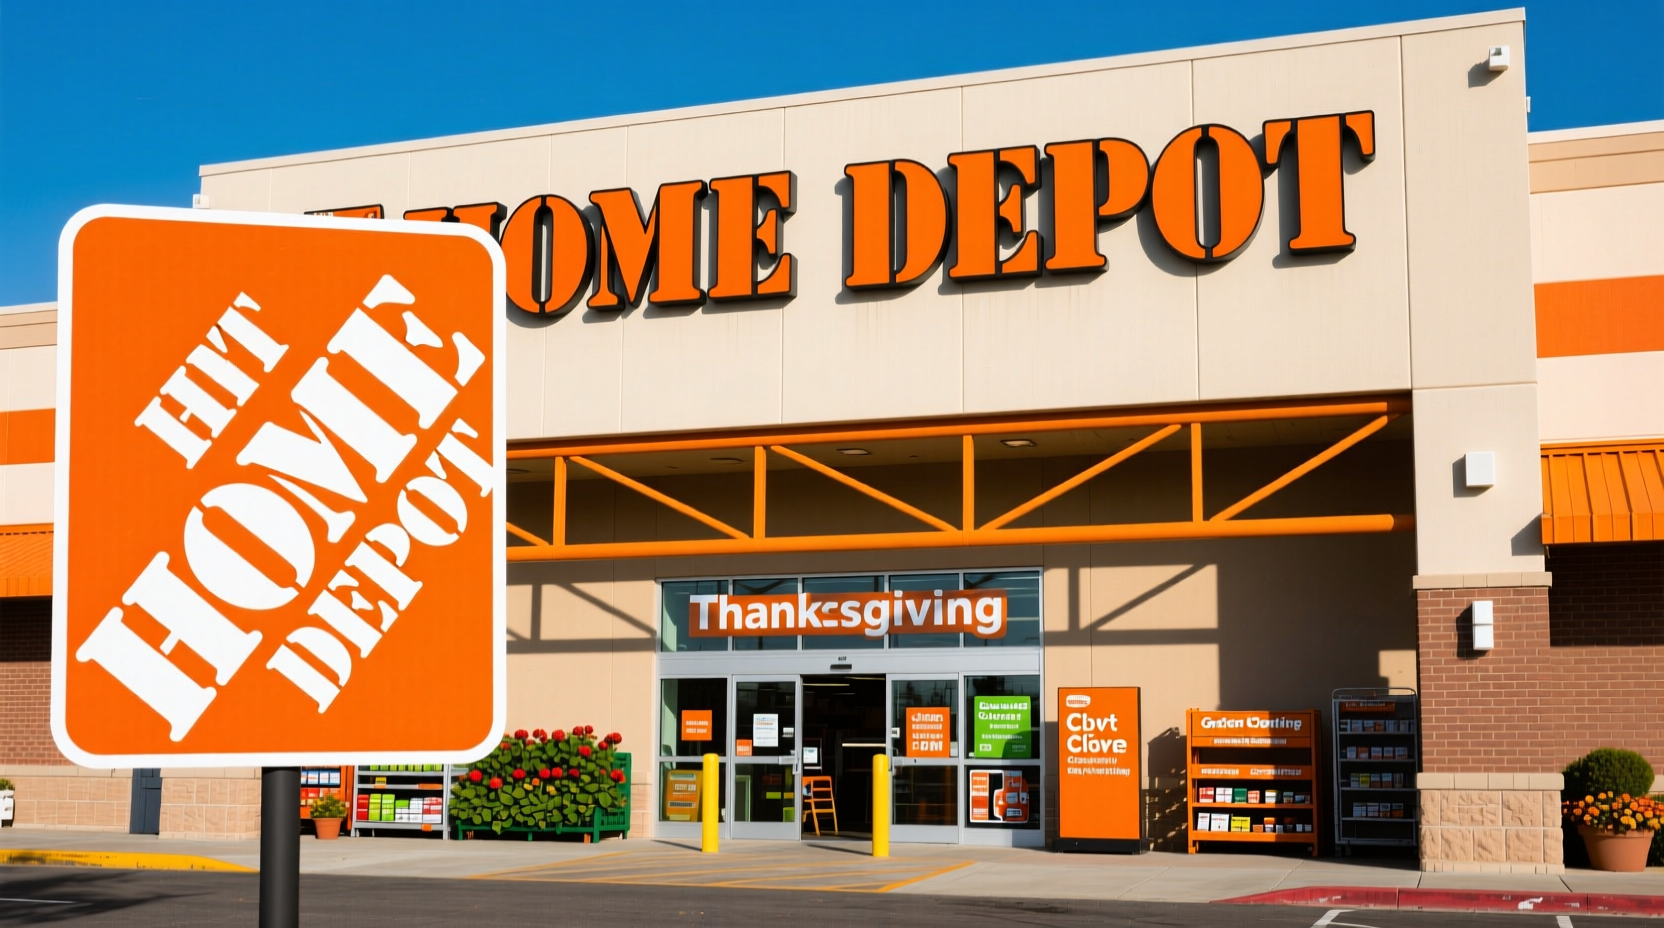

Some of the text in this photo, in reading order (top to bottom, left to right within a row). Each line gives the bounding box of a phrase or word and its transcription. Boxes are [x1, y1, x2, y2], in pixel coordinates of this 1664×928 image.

[403, 110, 1376, 317] OME DEPOT
[75, 274, 486, 741] HOME
[265, 417, 494, 714] DEPOT
